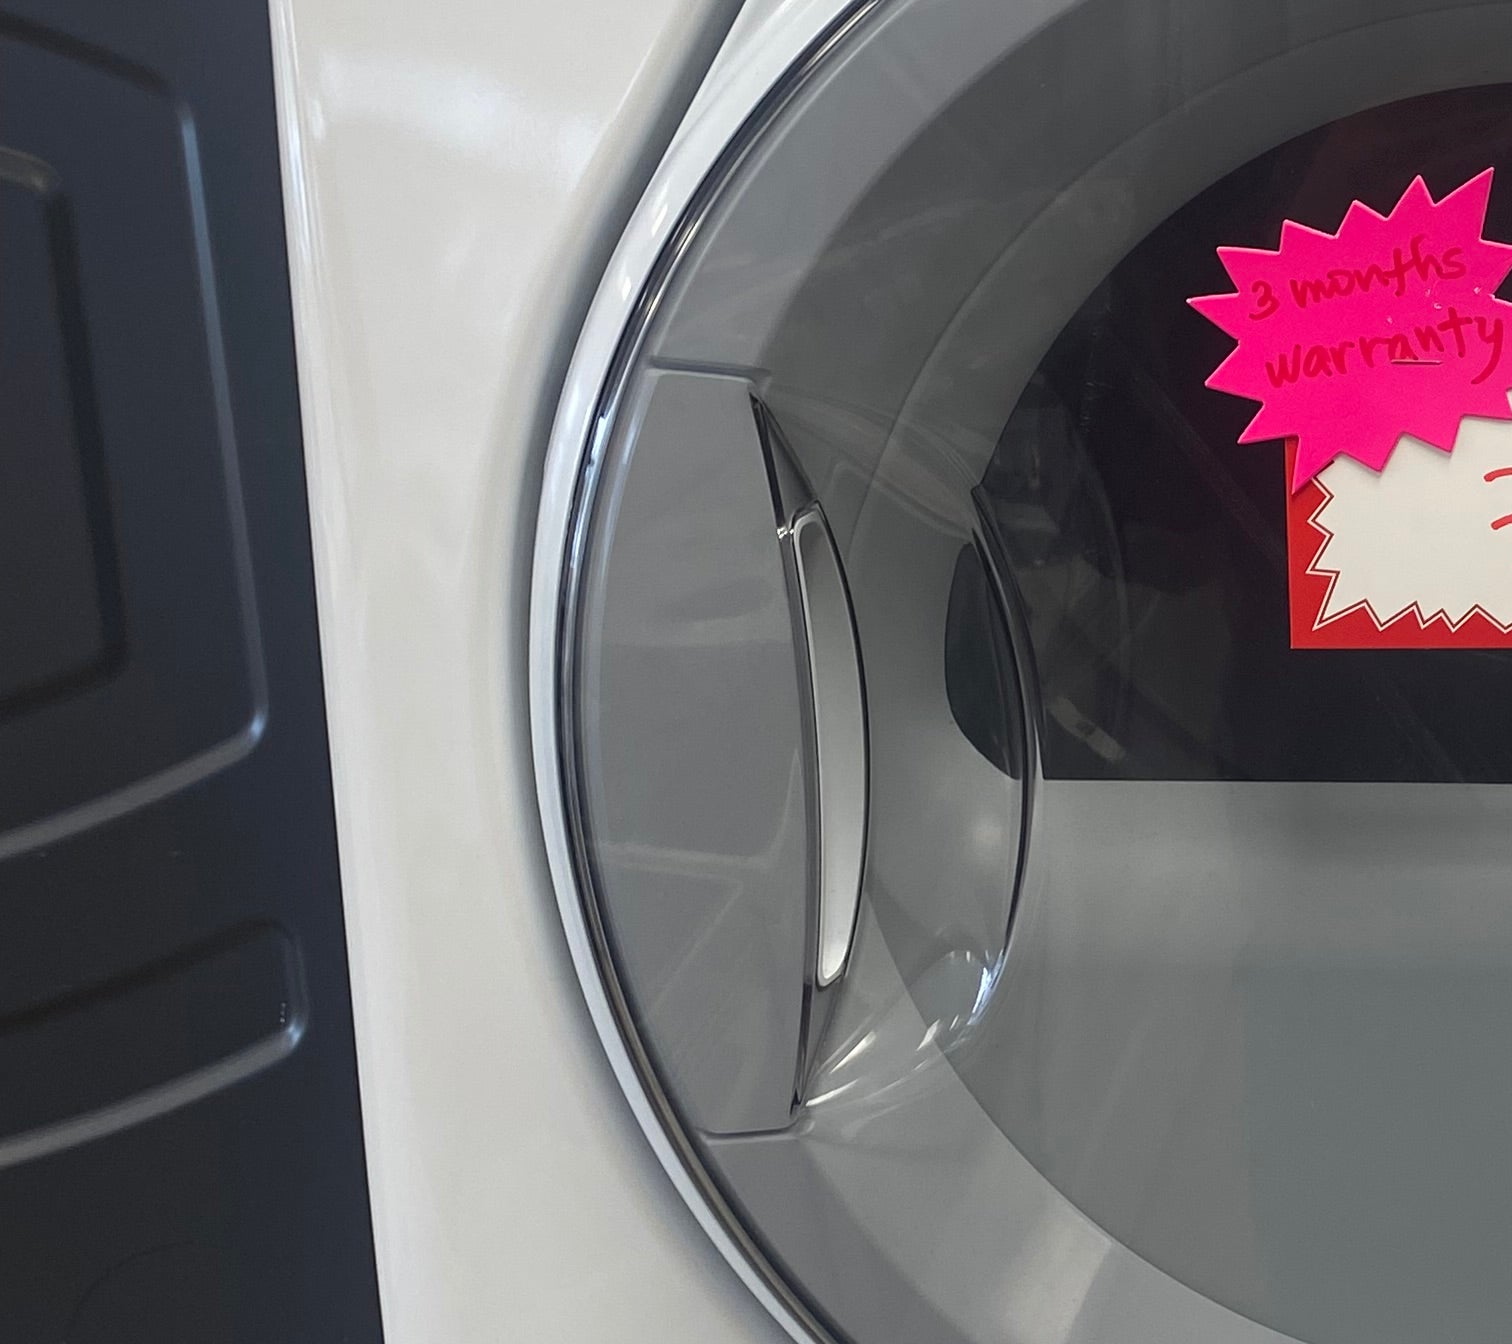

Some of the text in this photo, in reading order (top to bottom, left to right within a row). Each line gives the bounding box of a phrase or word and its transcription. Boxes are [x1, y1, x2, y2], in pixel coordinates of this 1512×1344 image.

[1247, 233, 1468, 321] 3 months
[1265, 307, 1504, 389] warranty
